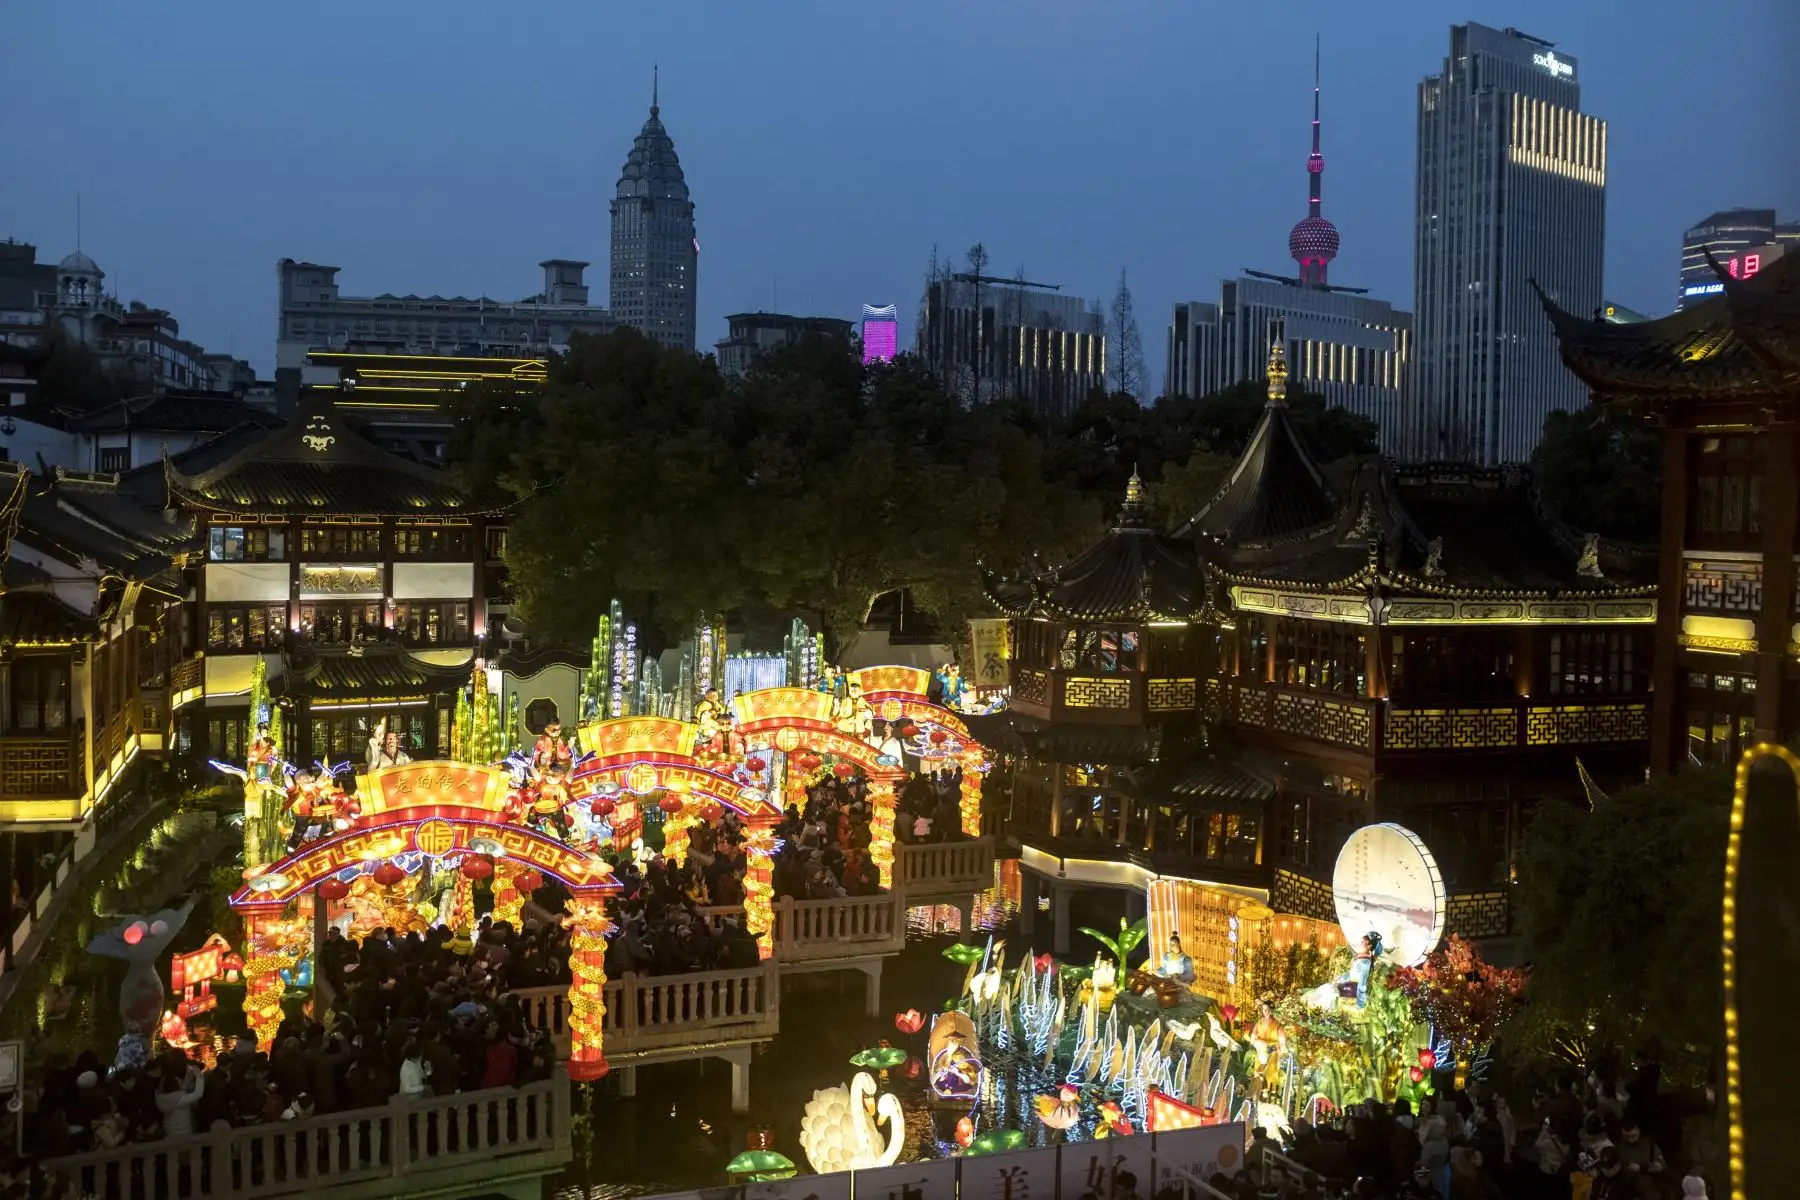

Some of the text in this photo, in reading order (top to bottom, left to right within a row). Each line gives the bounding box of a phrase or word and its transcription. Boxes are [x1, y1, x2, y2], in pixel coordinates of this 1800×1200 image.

[980, 652, 1004, 679] 茶
[608, 726, 672, 743] 龙的传人
[394, 774, 477, 795] 龙的传人
[629, 764, 657, 793] 福
[418, 820, 454, 855] 福
